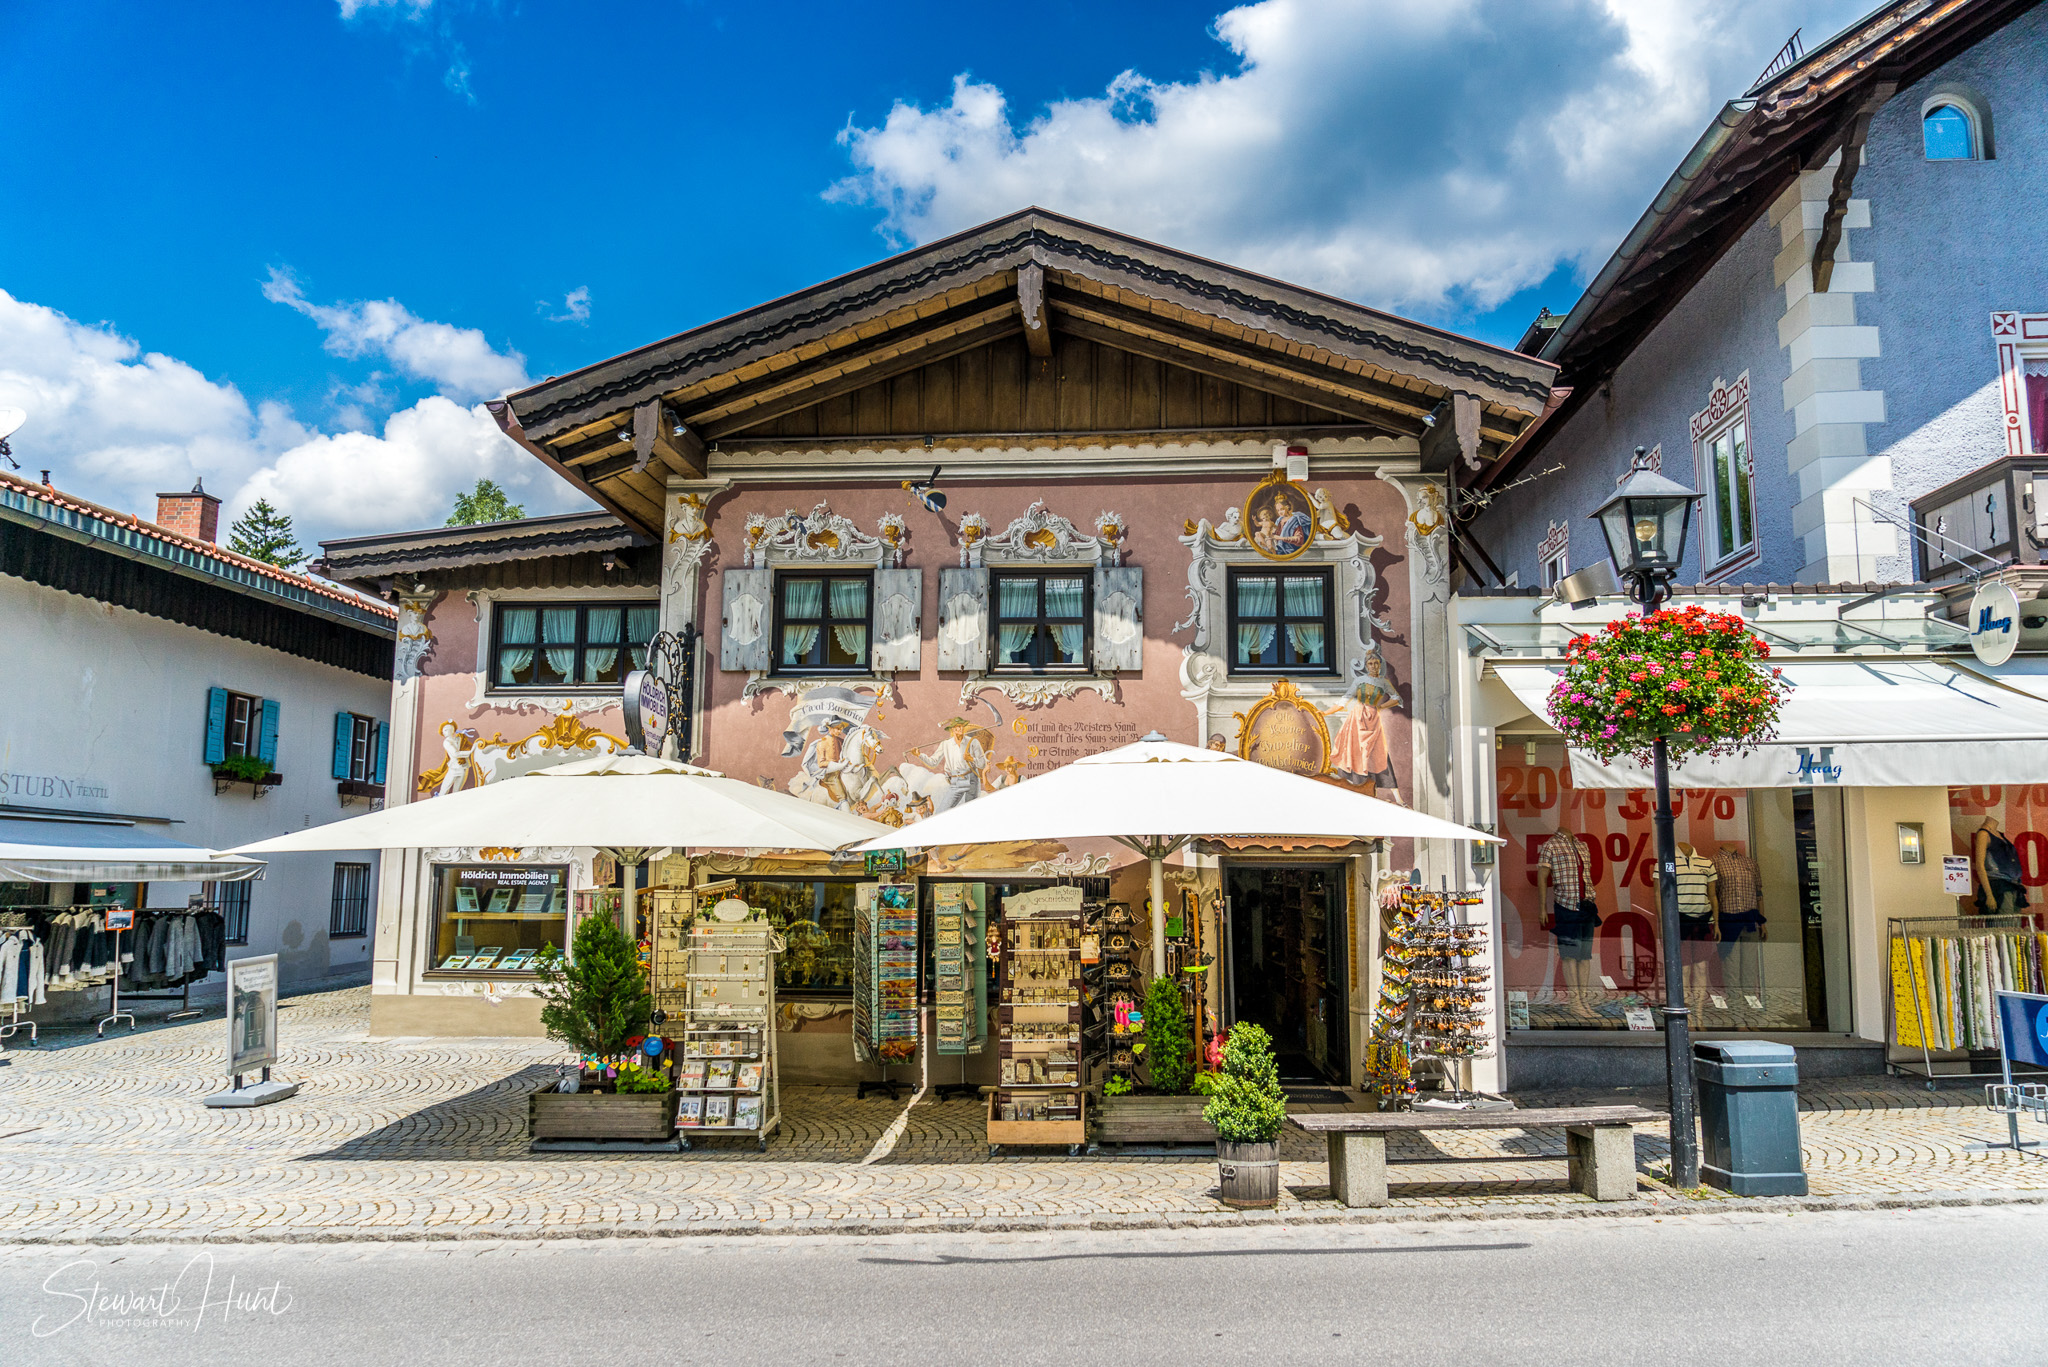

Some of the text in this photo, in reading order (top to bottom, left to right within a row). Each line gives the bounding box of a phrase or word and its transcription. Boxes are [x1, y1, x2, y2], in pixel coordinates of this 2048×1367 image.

[1971, 605, 2012, 635] Haag
[1041, 722, 1056, 732] und
[1058, 722, 1072, 732] des
[1074, 722, 1112, 732] Meisters
[1114, 722, 1136, 734] Hand
[1066, 733, 1083, 743] dies
[1085, 732, 1106, 743] Haus
[1028, 745, 1047, 758] Der
[1048, 747, 1080, 757] Straße
[1028, 760, 1045, 770] dem
[1787, 753, 1843, 779] Haag
[76, 785, 109, 798] TEXTIL
[461, 871, 549, 880] Höldrich Immobilien
